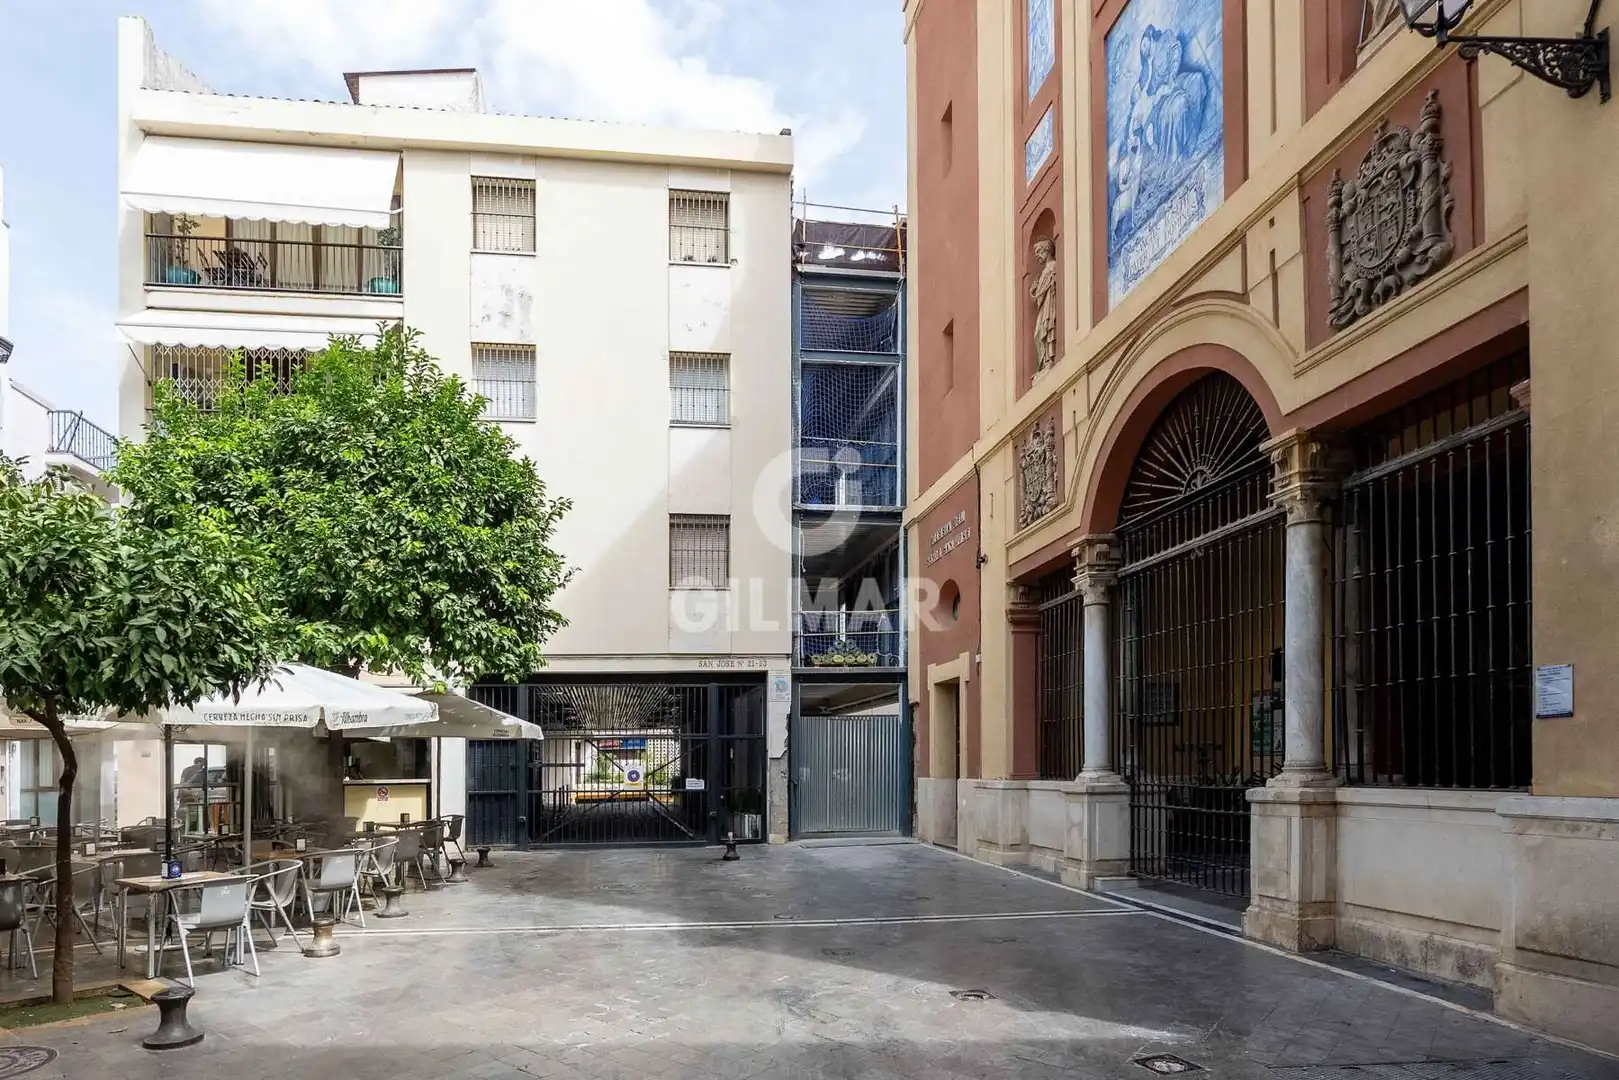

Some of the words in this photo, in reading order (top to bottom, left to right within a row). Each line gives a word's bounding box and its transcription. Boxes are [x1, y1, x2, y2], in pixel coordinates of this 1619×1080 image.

[698, 660, 713, 668] SAN
[203, 712, 238, 721] CERVEZA
[240, 712, 266, 721] HECHA
[283, 713, 309, 722] PRISA
[339, 710, 368, 724] Alhambra
